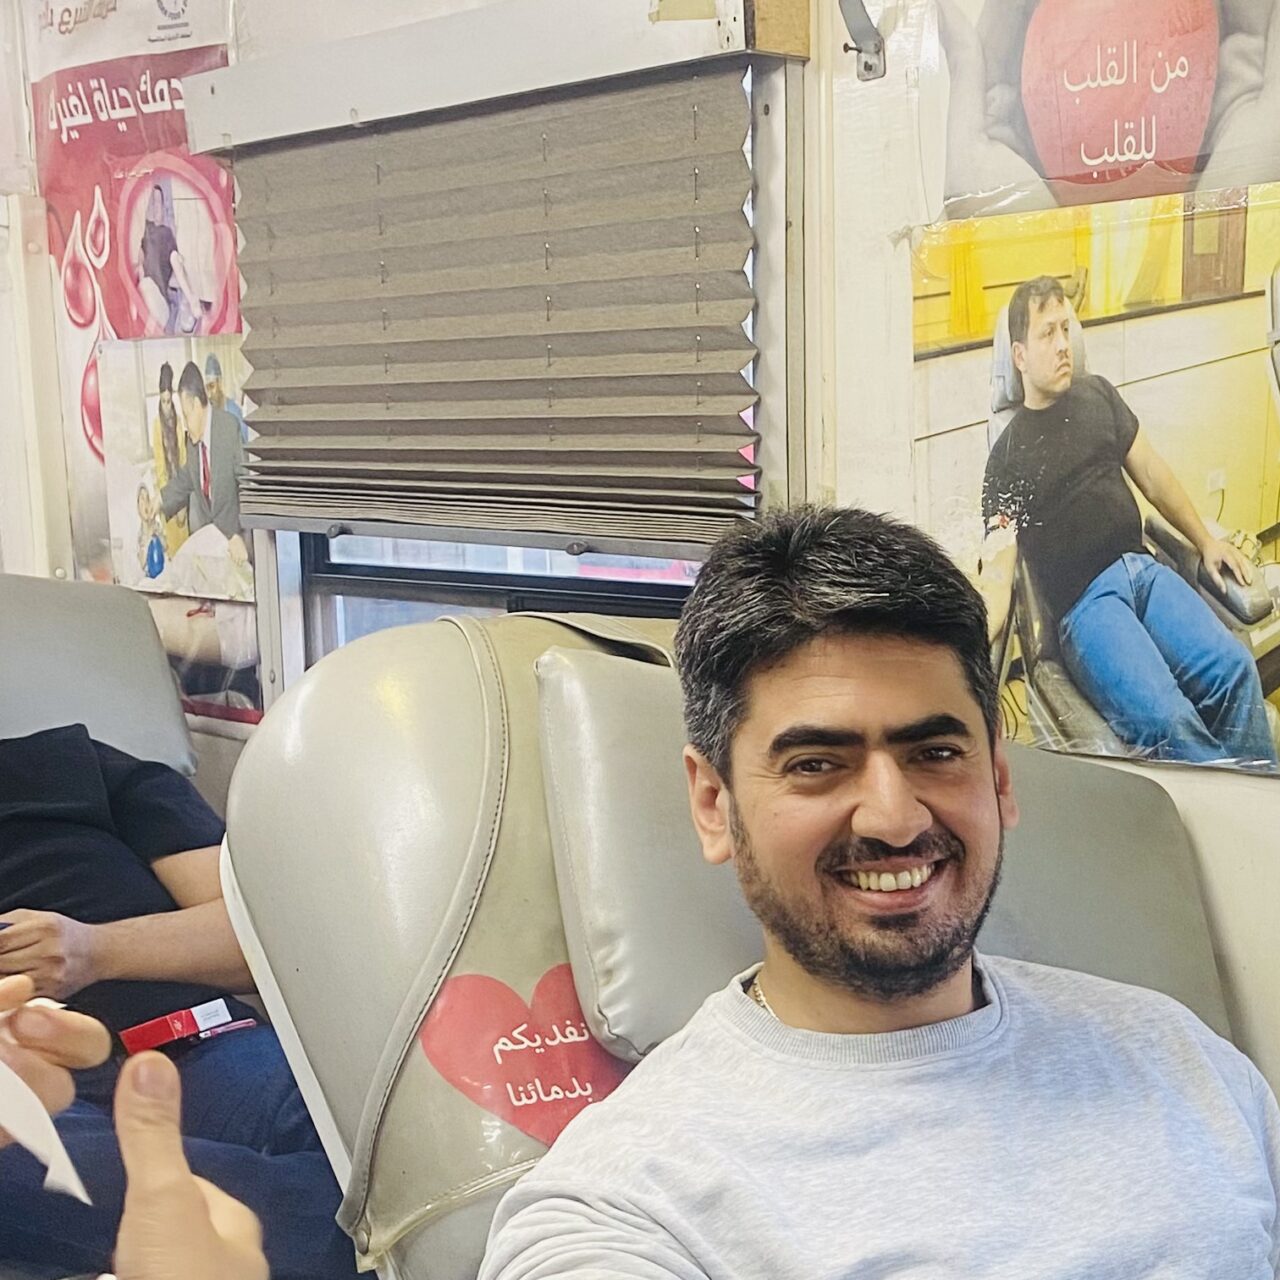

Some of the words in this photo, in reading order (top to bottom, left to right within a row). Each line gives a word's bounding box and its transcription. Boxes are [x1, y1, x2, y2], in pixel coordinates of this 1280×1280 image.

[1063, 40, 1138, 105] القلب
[1151, 50, 1189, 93] من
[89, 78, 137, 132] حياة
[1080, 114, 1157, 178] للقلب
[492, 1020, 590, 1064] نفديكم
[505, 1076, 593, 1106] بدمائنا
